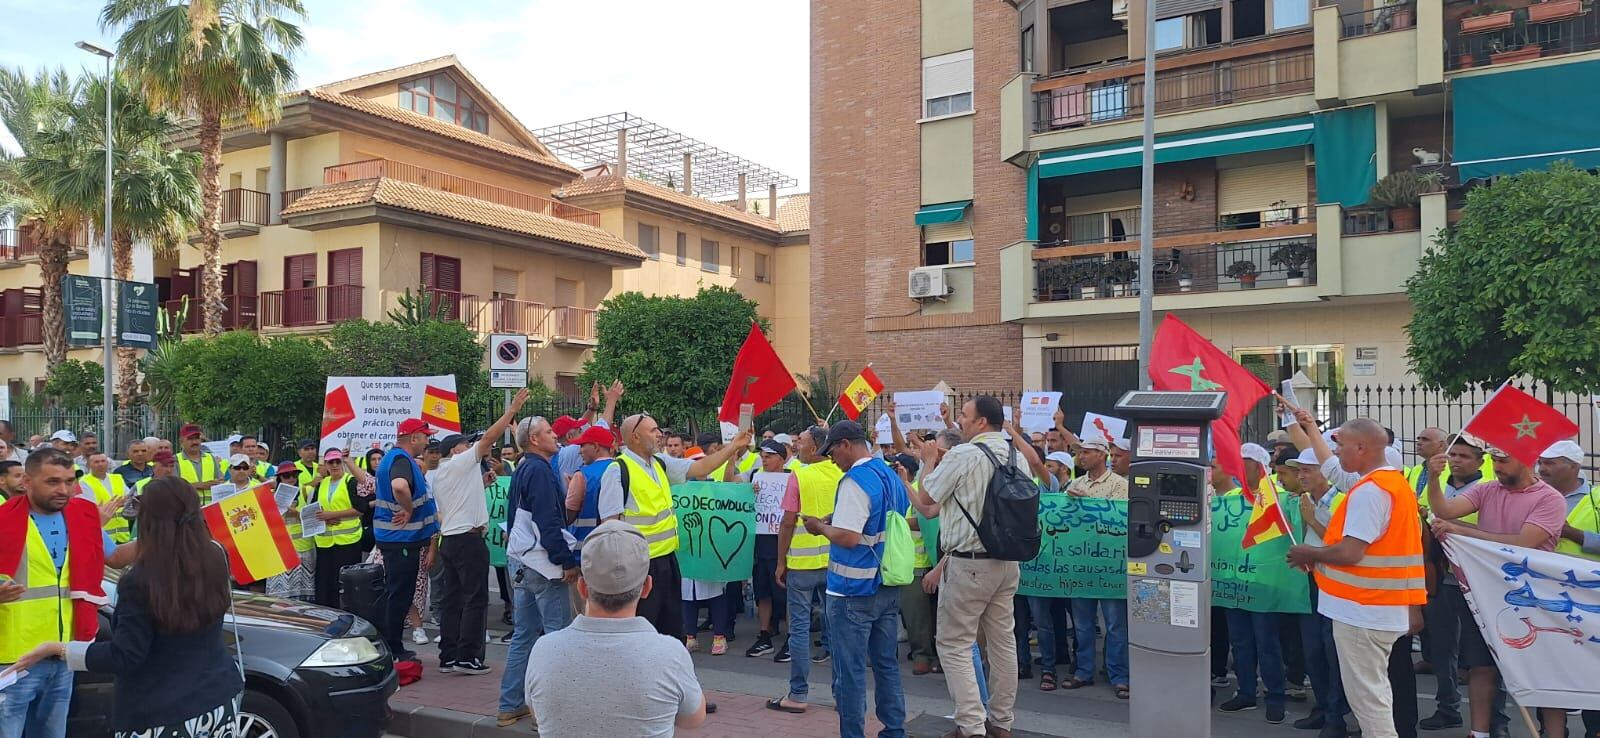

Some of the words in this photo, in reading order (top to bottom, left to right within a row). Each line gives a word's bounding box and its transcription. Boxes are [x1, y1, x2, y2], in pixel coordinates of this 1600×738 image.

[360, 380, 374, 390] Que
[382, 381, 412, 391] permita,
[361, 393, 368, 401] al
[393, 393, 412, 402] hacer
[363, 405, 379, 414] solo
[379, 406, 387, 414] la
[387, 406, 411, 416] prueba
[362, 418, 395, 428] práctica
[336, 431, 369, 440] obtener
[370, 432, 378, 440] el
[1052, 539, 1064, 557] la
[1053, 558, 1070, 574] las
[1238, 552, 1257, 574] de
